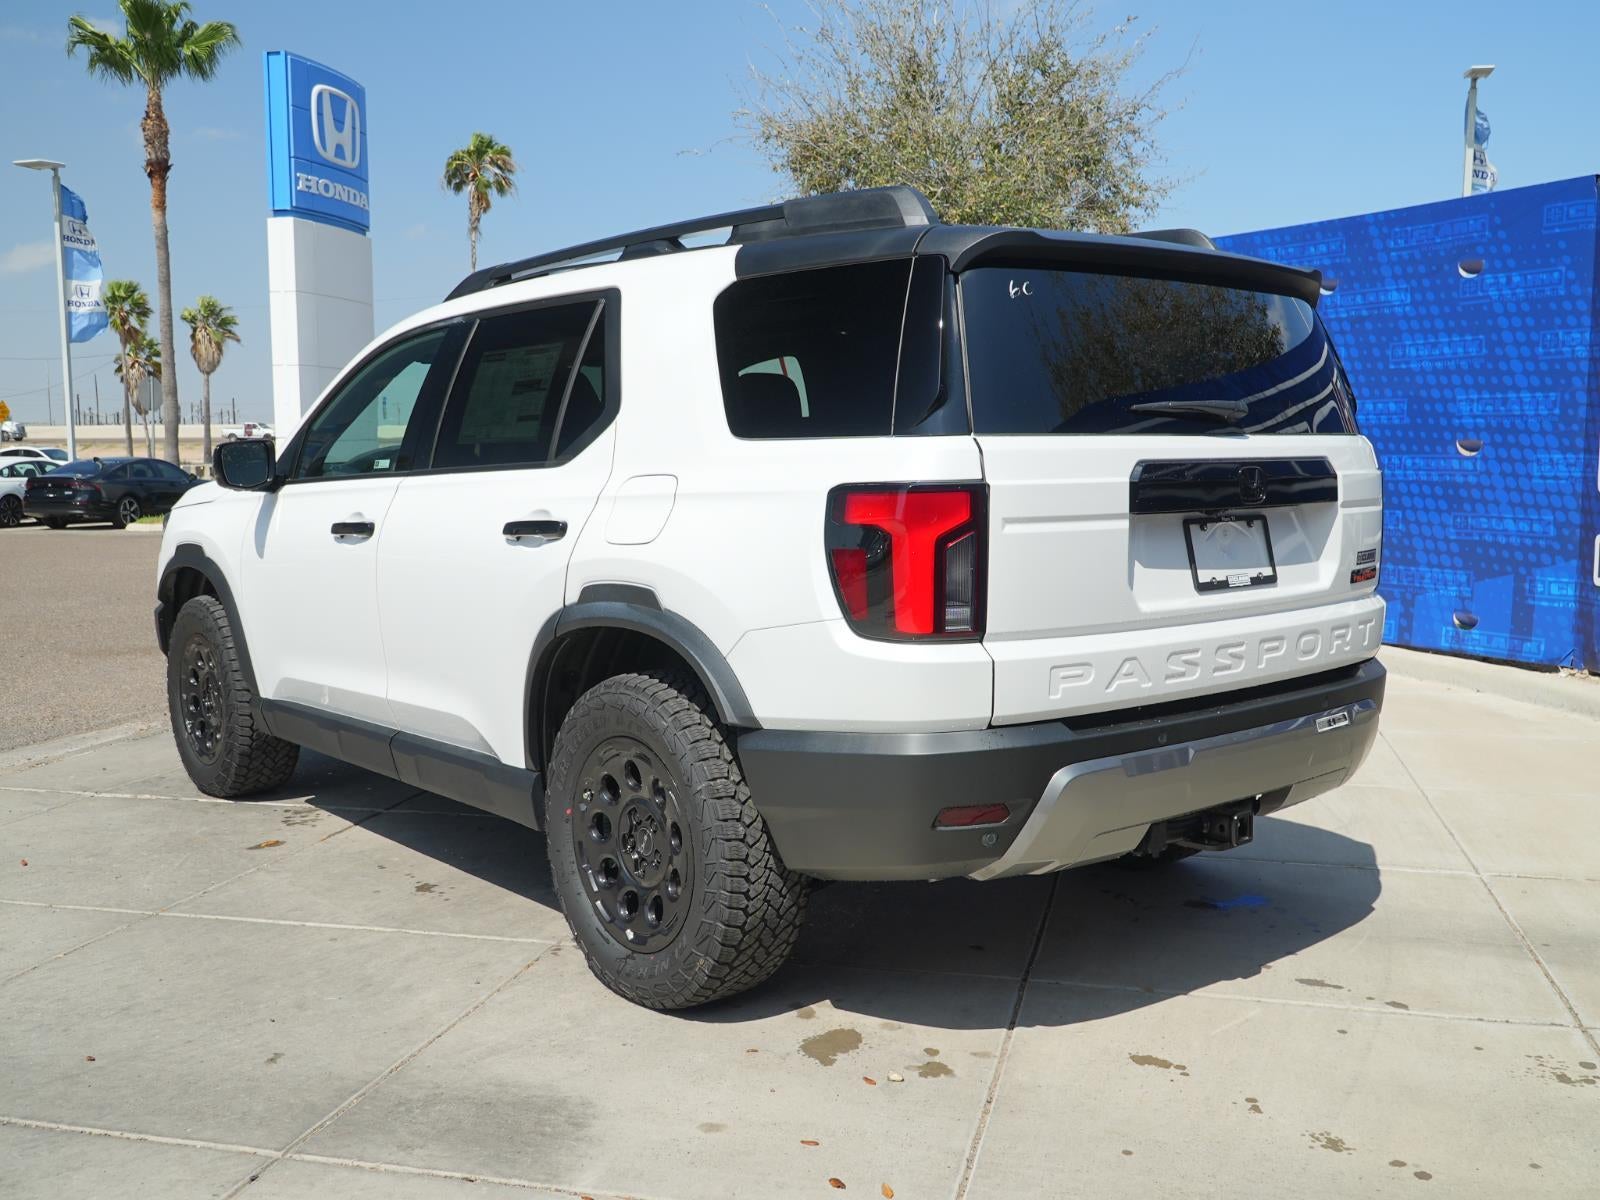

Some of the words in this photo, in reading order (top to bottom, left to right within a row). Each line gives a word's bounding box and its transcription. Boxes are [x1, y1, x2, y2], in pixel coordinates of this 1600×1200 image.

[1472, 168, 1497, 182] NDA
[296, 172, 369, 210] HONDA
[63, 234, 96, 247] HONDA
[67, 299, 101, 308] HONDA
[1049, 618, 1376, 699] PASSPORT
